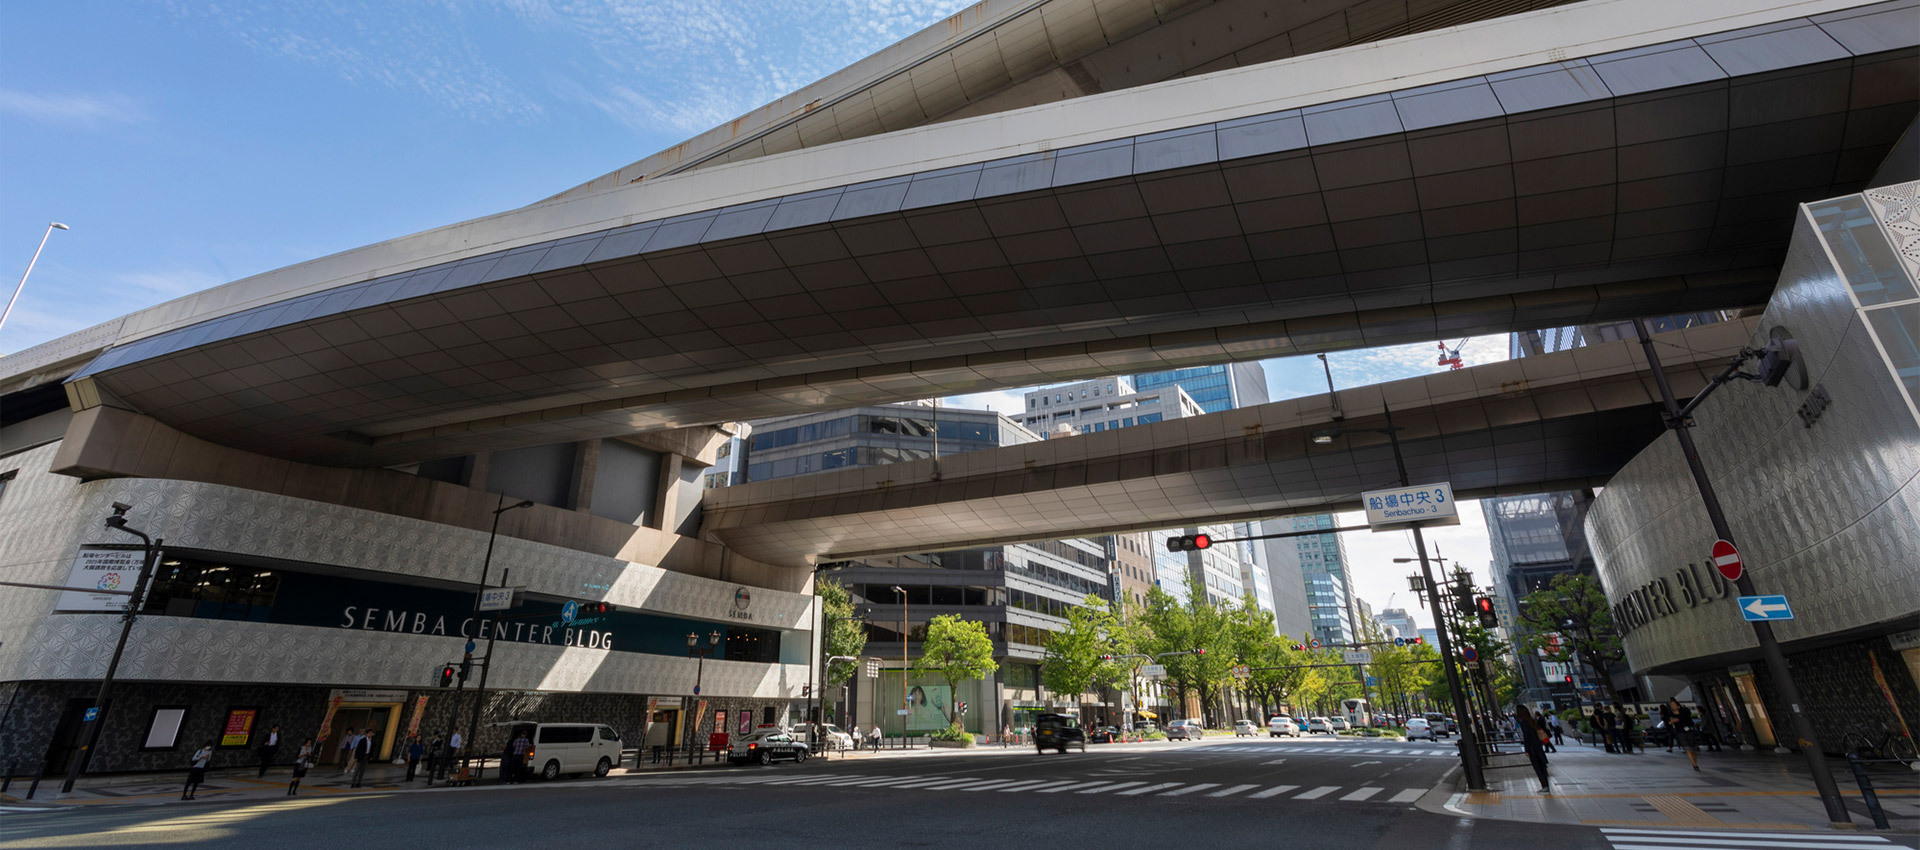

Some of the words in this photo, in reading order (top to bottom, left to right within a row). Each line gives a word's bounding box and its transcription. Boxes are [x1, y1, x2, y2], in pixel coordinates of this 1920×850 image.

[1384, 508, 1425, 518] Senbachuo
[1676, 557, 1728, 609] BLD
[341, 605, 446, 636] SEMBA
[461, 617, 553, 645] CENTER
[564, 628, 612, 650] BLDG
